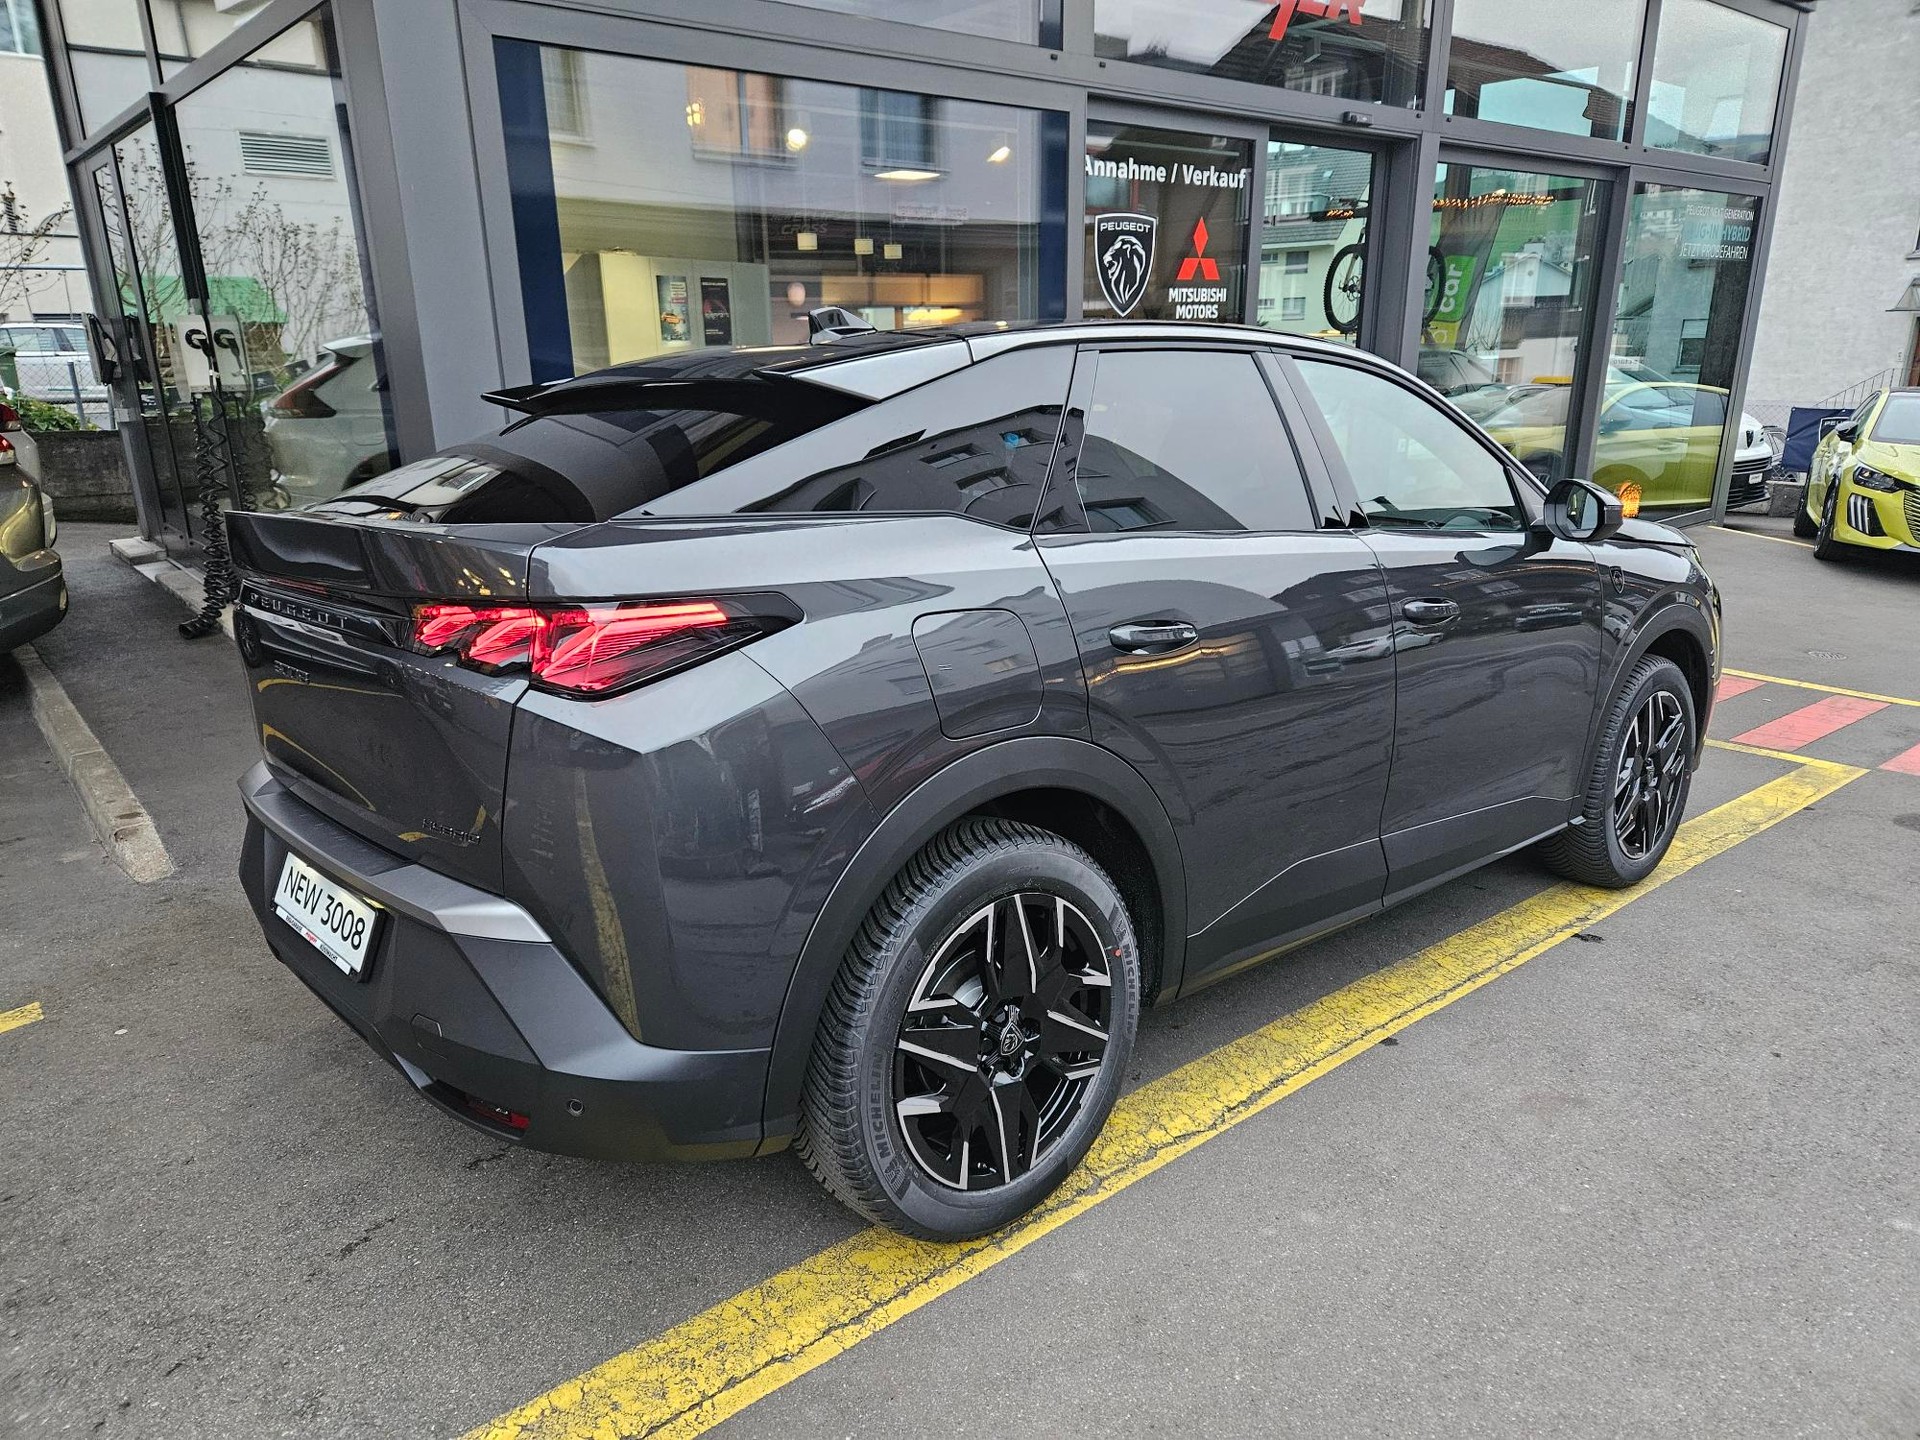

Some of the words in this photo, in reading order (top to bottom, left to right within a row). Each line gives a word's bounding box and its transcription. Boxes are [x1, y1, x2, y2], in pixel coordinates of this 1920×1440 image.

[1085, 154, 1166, 183] Annahme
[1170, 163, 1179, 184] /
[1182, 164, 1246, 189] Verkauf
[1100, 222, 1151, 233] PEUGEOT
[1724, 208, 1754, 221] GENERATION
[1721, 224, 1751, 242] HYBRID
[1679, 242, 1701, 257] JETZT
[1701, 243, 1749, 260] PROBEFAHREN
[1168, 288, 1227, 303] MITSUBISHI
[1440, 264, 1463, 313] car
[1176, 305, 1219, 319] MOTORS
[250, 592, 348, 629] PEUGEOT
[283, 865, 323, 915] NEW
[321, 893, 366, 951] 3008
[1122, 943, 1136, 1034] MICHELIN
[870, 1048, 892, 1159] MICHELIN
